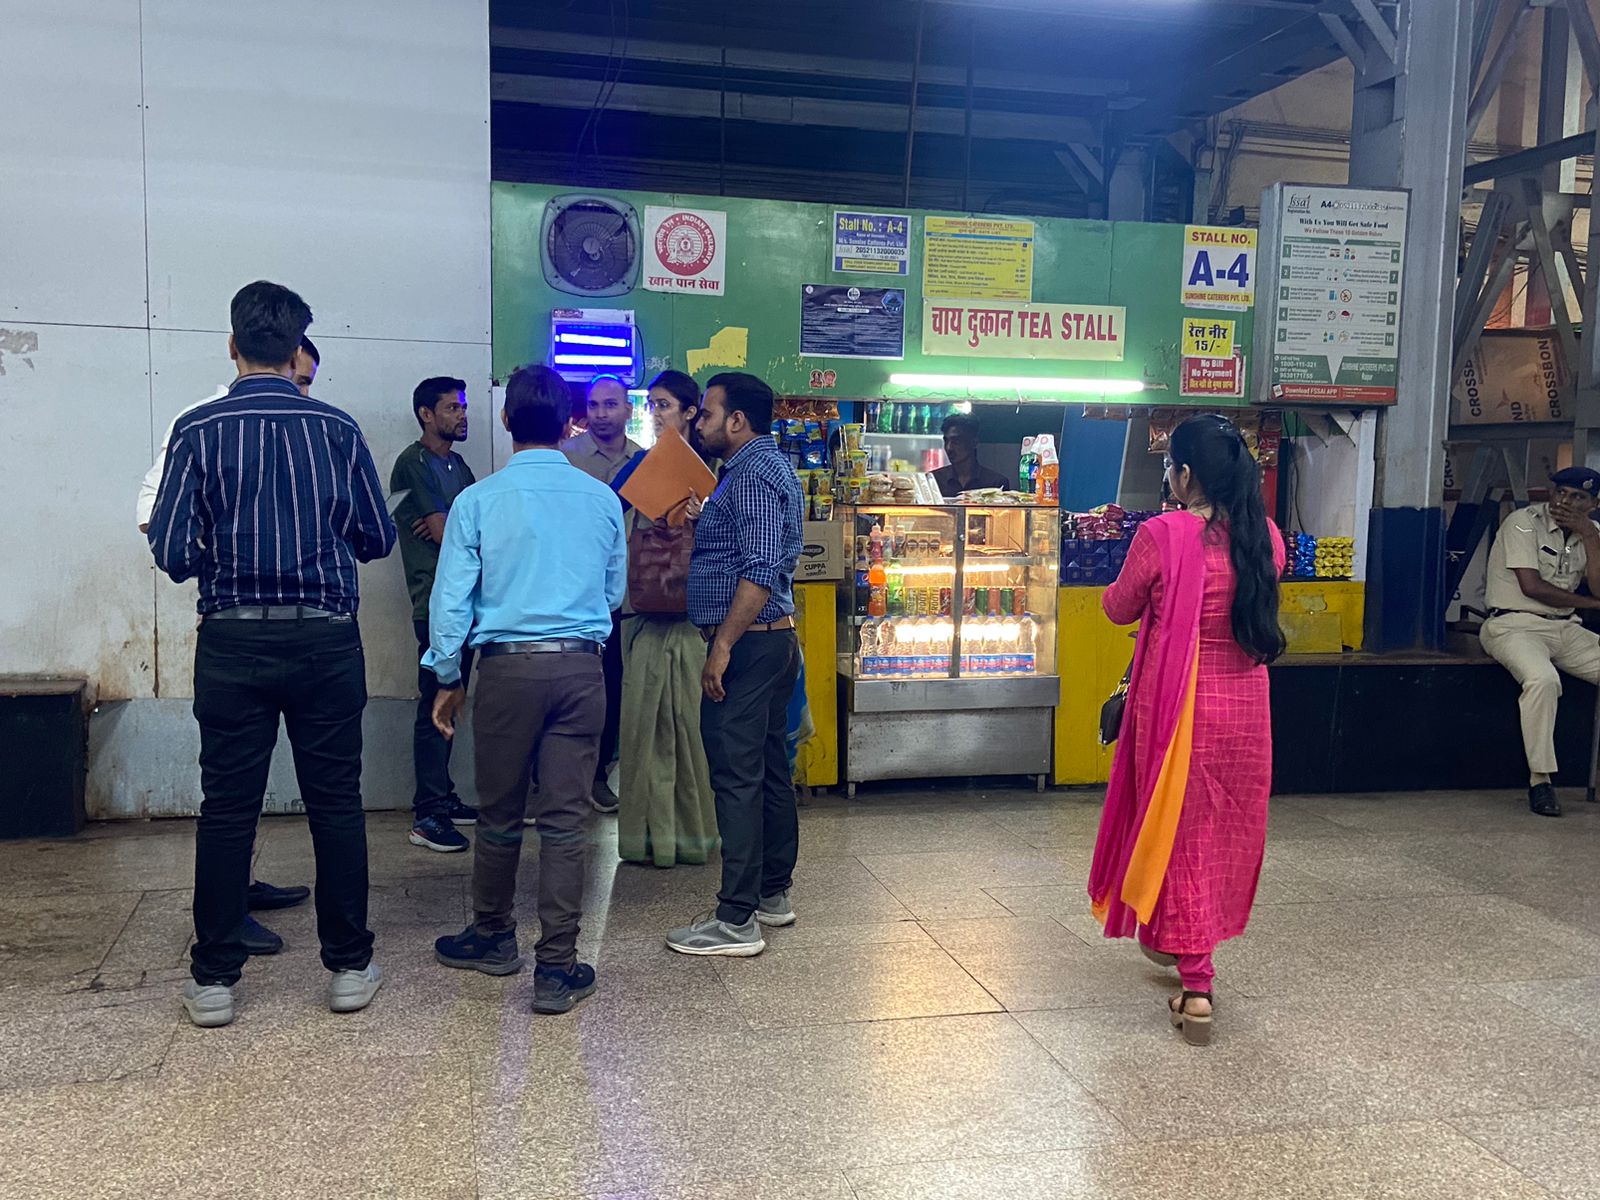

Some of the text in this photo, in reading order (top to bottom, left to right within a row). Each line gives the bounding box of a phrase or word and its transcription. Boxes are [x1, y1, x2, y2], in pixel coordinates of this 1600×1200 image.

[839, 217, 860, 231] Stall
[862, 219, 876, 232] No.
[887, 220, 903, 233] A-4
[682, 214, 714, 265] INDIAN RAILWAYS
[1192, 231, 1251, 244] STALL NO.
[1188, 250, 1249, 288] A-4
[648, 276, 720, 290] खान पान सेवा
[931, 307, 963, 336] चाय
[968, 309, 1014, 347] दुकान
[1018, 311, 1052, 339] TEA
[1061, 312, 1117, 341] STALL
[1189, 322, 1228, 339] रेल नीर
[1195, 340, 1221, 352] 15/-
[1201, 360, 1224, 368] No Bill
[1192, 369, 1233, 378] No Payment
[1538, 337, 1561, 418] CROSSBON
[1285, 387, 1310, 395] Download
